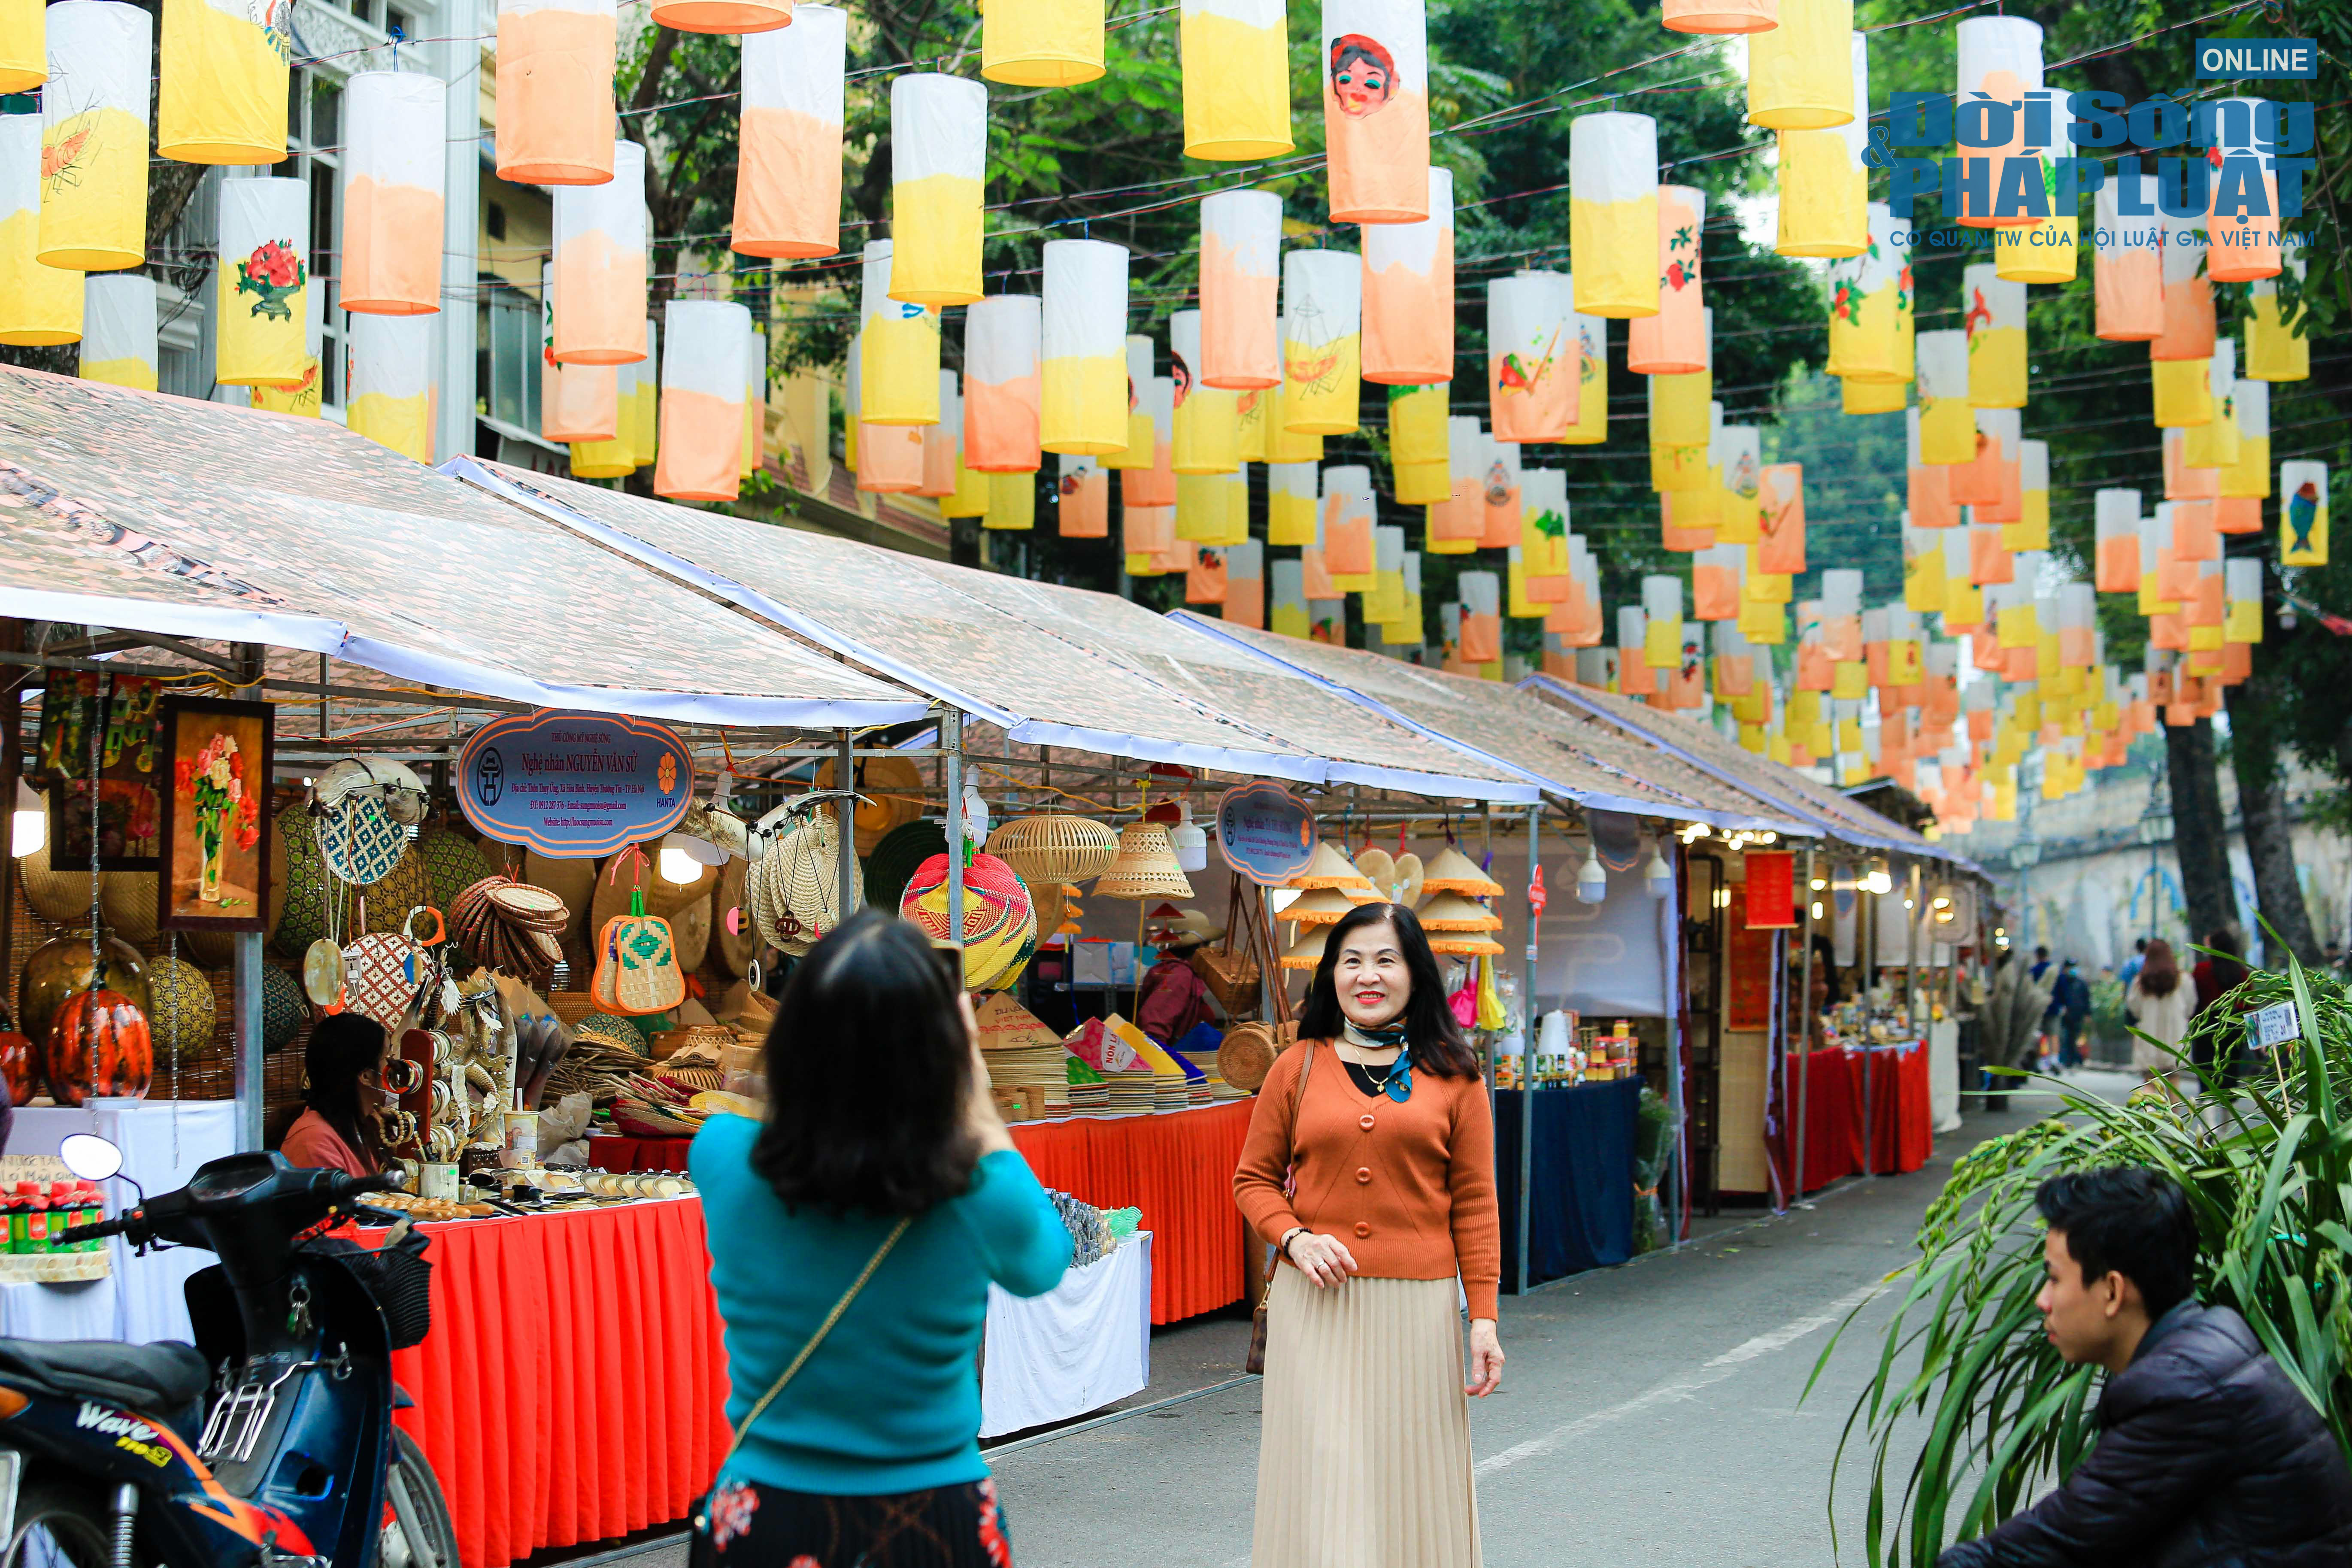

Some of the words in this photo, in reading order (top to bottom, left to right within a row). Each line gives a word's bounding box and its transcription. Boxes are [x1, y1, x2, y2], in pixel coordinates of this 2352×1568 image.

[522, 752, 543, 776] Nghệ
[544, 753, 564, 771] nhân
[566, 748, 605, 772] NGUYỄN
[606, 752, 624, 772] VĂN
[625, 750, 638, 773] SỬ
[530, 800, 538, 810] ĐT:
[539, 800, 549, 810] 0912
[657, 798, 676, 807] HANTA
[1106, 1045, 1116, 1064] NÓN
[76, 1400, 160, 1441] Wave
